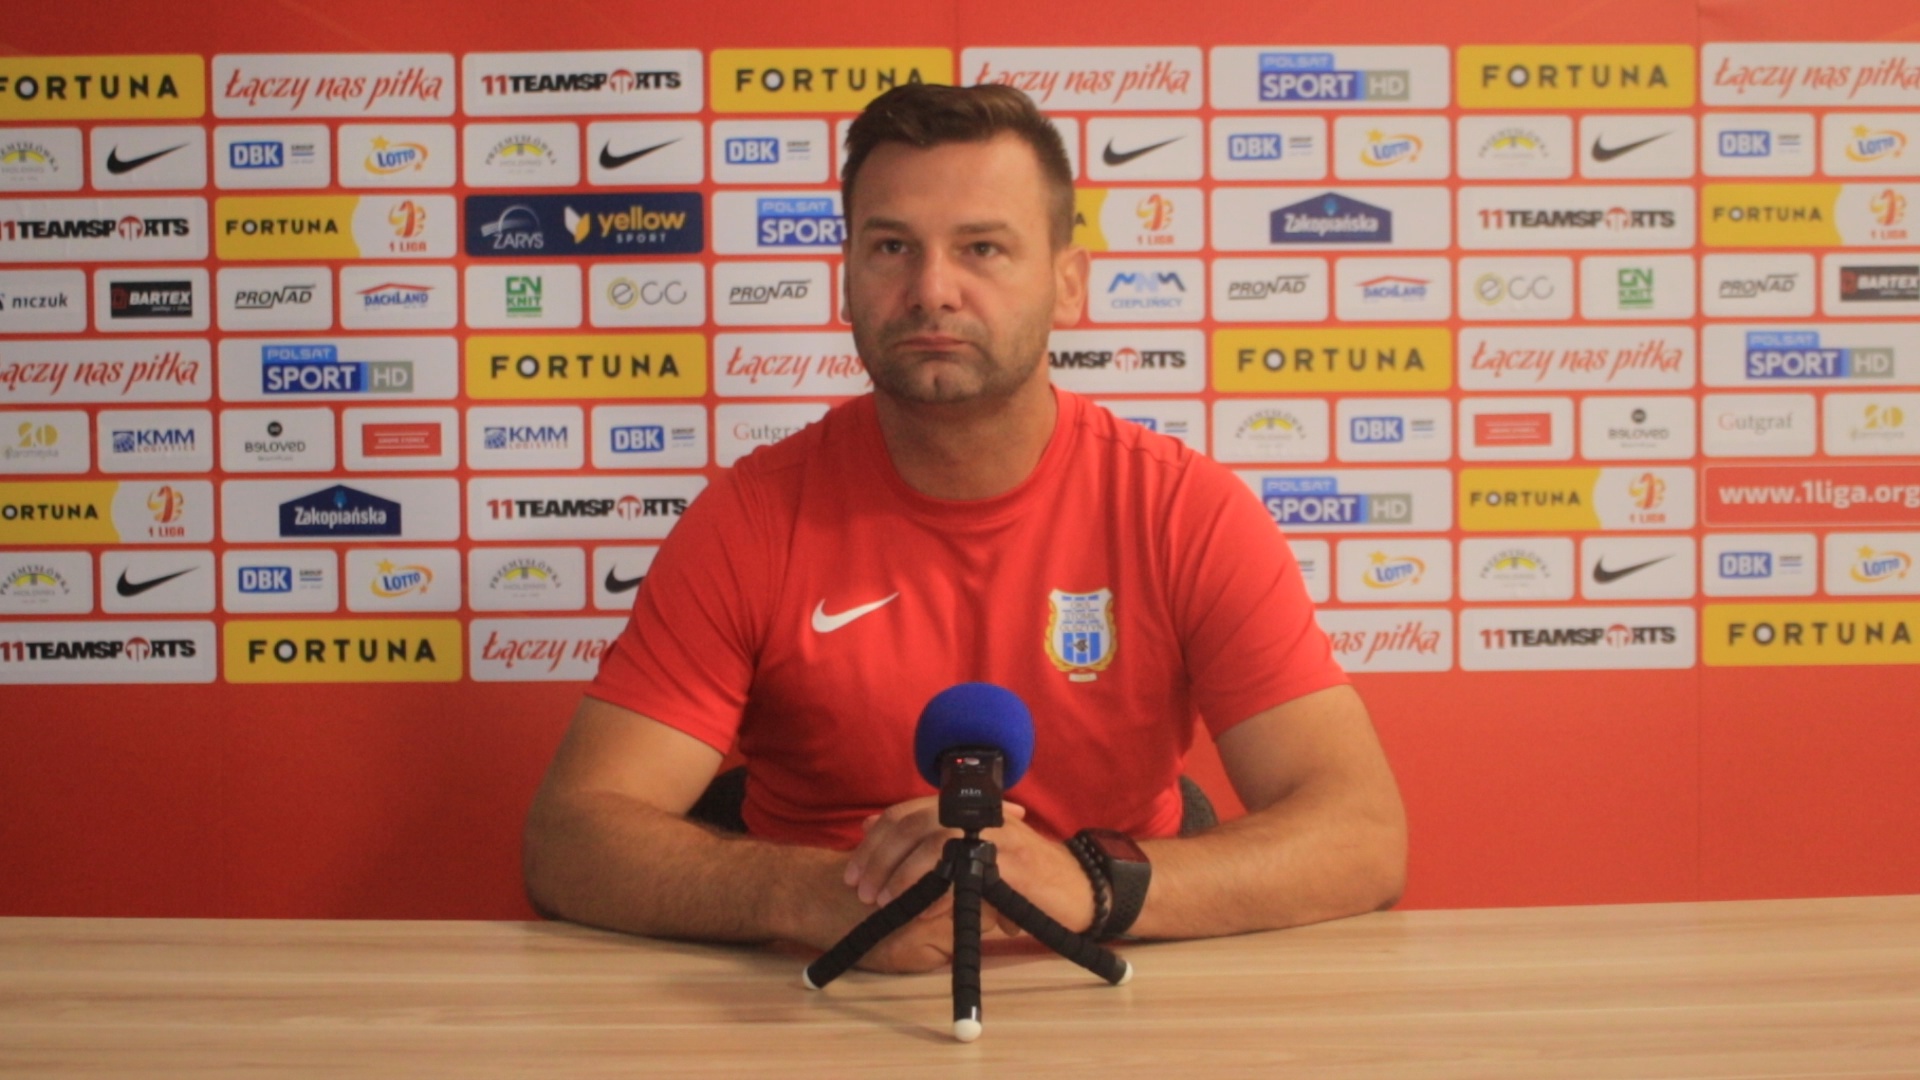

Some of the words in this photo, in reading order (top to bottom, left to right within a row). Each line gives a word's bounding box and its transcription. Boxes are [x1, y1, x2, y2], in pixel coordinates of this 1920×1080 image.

[1264, 57, 1328, 68] POLSAT
[1063, 70, 1115, 94] nas
[1113, 62, 1190, 104] piłka
[1263, 74, 1353, 98] SPORT
[1369, 76, 1404, 95] HD
[1482, 64, 1668, 88] FORTUNA
[1714, 57, 1798, 98] Łączy
[1802, 66, 1851, 90] nas
[1848, 57, 1920, 99] piłka
[225, 68, 312, 110] Łączy
[316, 75, 366, 104] nas
[365, 68, 443, 110] piłka
[233, 144, 280, 166] DBK
[729, 140, 776, 162] DBK
[1232, 137, 1277, 158] DBK
[1373, 141, 1410, 160] LOTTO
[1722, 133, 1769, 155] DBK
[1858, 136, 1895, 156] LOTTO
[377, 149, 416, 168] LOTTO
[763, 201, 828, 213] POLSAT
[1713, 206, 1822, 222] FORTUNA
[0, 215, 189, 241] 1TEAMSPORTS
[226, 219, 338, 234] FORTUNA
[597, 206, 685, 238] yellow
[762, 219, 847, 243] SPORT
[1284, 212, 1378, 236] Zakopiańska
[389, 242, 395, 252] 1
[399, 242, 427, 252] LIGA
[493, 232, 544, 250] ZARYS
[617, 233, 666, 244] SPORT
[729, 280, 810, 304] PRONAD
[1229, 275, 1309, 300] PRONAD
[1364, 284, 1426, 298] DACHLAND
[1719, 273, 1798, 298] PRONAD
[1858, 274, 1919, 290] BARTEX
[129, 291, 191, 306] BARTEX
[234, 284, 315, 309] PRONAD
[364, 290, 428, 306] DACHLAND
[506, 296, 542, 306] KNIT
[1750, 334, 1815, 346] POLSAT
[267, 347, 331, 360] POLSAT
[1049, 347, 1186, 372] AMSPORTS
[1238, 348, 1425, 372] FORTUNA
[1471, 342, 1554, 381] Łączy
[1560, 348, 1607, 372] nas
[1607, 341, 1683, 381] piłka
[1750, 352, 1838, 376] SPORT
[1854, 354, 1888, 373] HD
[0, 362, 69, 396] ączy
[73, 358, 124, 386] nas
[123, 352, 199, 394] piłka
[491, 354, 679, 378] FORTUNA
[726, 346, 812, 388] Łączy
[816, 355, 866, 379] nas
[267, 366, 356, 390] SPORT
[373, 368, 407, 388] HD
[733, 423, 801, 444] Gutgr
[1354, 420, 1400, 441] DBK
[1718, 411, 1793, 435] Gutgraf
[137, 429, 195, 445] KMM
[510, 427, 568, 442] KMM
[614, 427, 660, 450] DBK
[1268, 481, 1331, 492] POLSAT
[1718, 480, 1920, 509] www.1liga.org
[1266, 498, 1356, 521] SPORT
[1373, 501, 1407, 519] HD
[1471, 490, 1581, 507] FORTUNA
[2, 504, 98, 520] ORTUNA
[294, 507, 386, 528] Zakopiańska
[149, 527, 154, 537] 1
[158, 527, 185, 537] LIGA
[1376, 563, 1413, 583] LOTTO
[1722, 554, 1769, 576] DBK
[1863, 556, 1899, 577] LOTTO
[242, 569, 288, 590] DBK
[383, 571, 420, 591] LOTTO
[1363, 621, 1440, 665] piłka
[1728, 622, 1911, 646] FORTUNA
[249, 638, 436, 663] FORTUNA
[482, 631, 567, 672] Łączy
[572, 639, 617, 663] na
